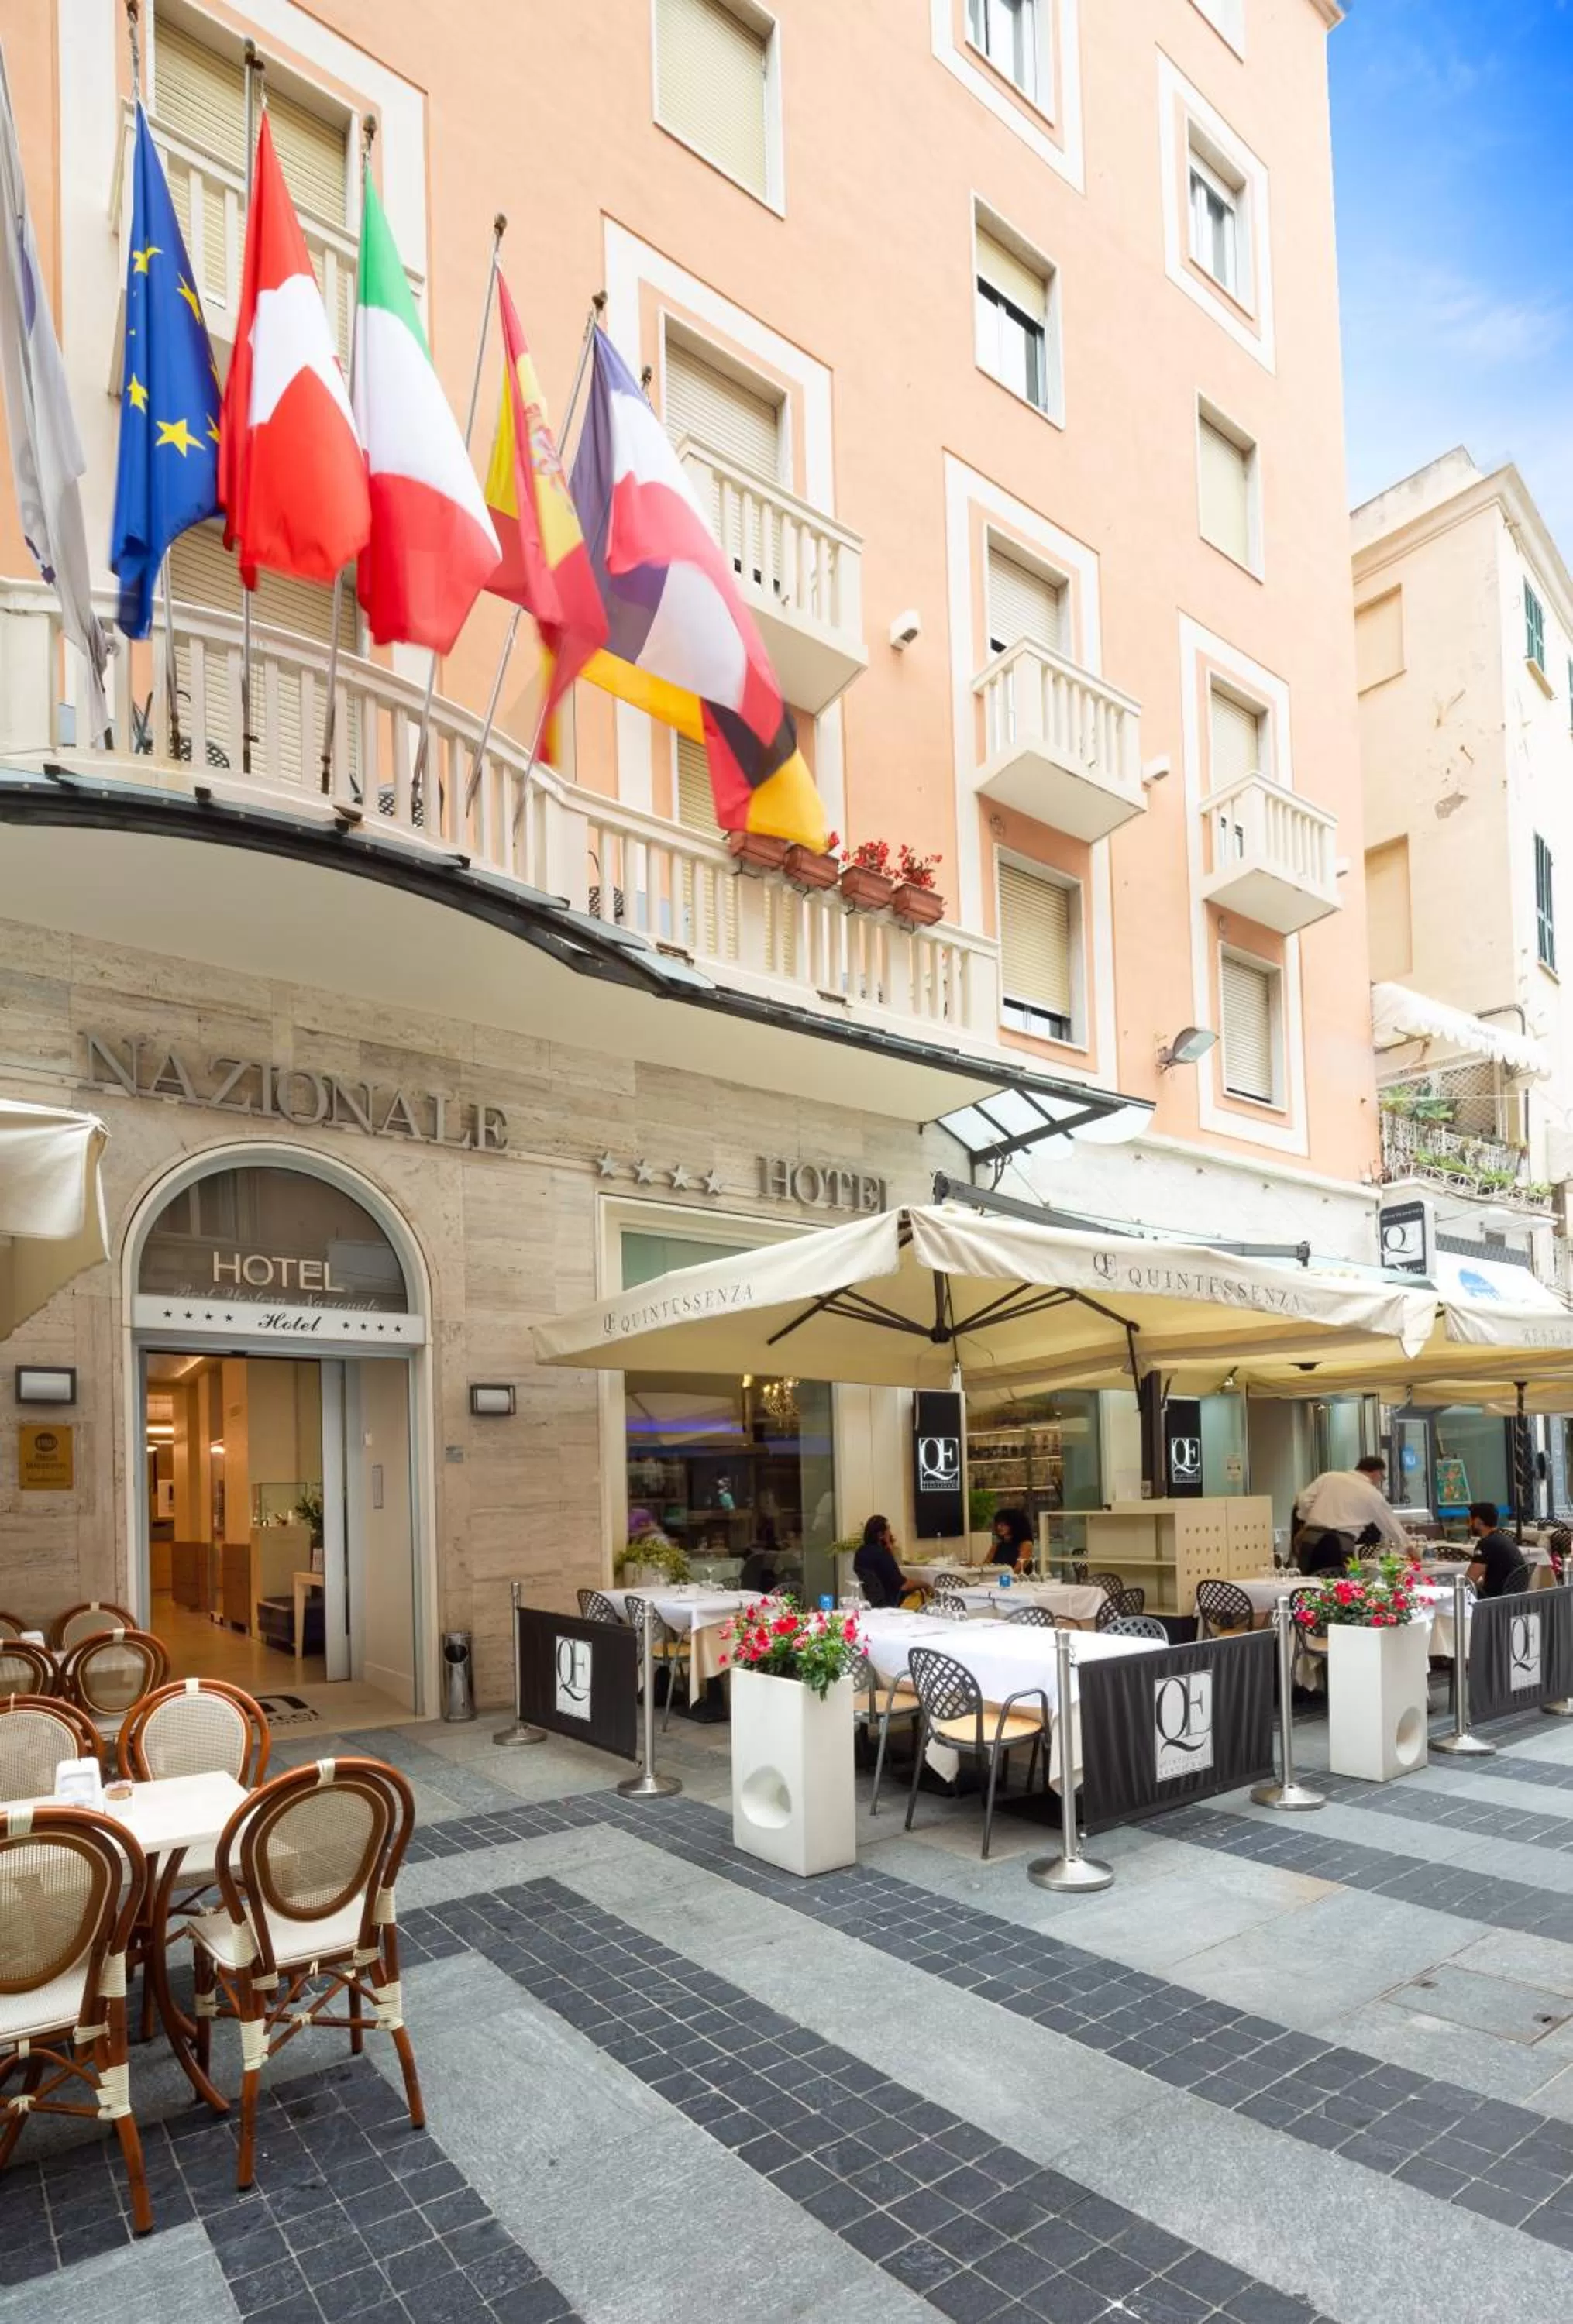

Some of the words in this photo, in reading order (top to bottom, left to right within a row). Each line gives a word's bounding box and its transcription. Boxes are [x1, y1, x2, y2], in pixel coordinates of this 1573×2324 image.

[80, 1032, 509, 1153] NAZIONALE
[213, 1251, 345, 1293] HOTEL
[1128, 1267, 1301, 1311] QUINTESSENZA
[258, 1312, 322, 1333] Hotel
[621, 1283, 754, 1332] QUINTESSENZA
